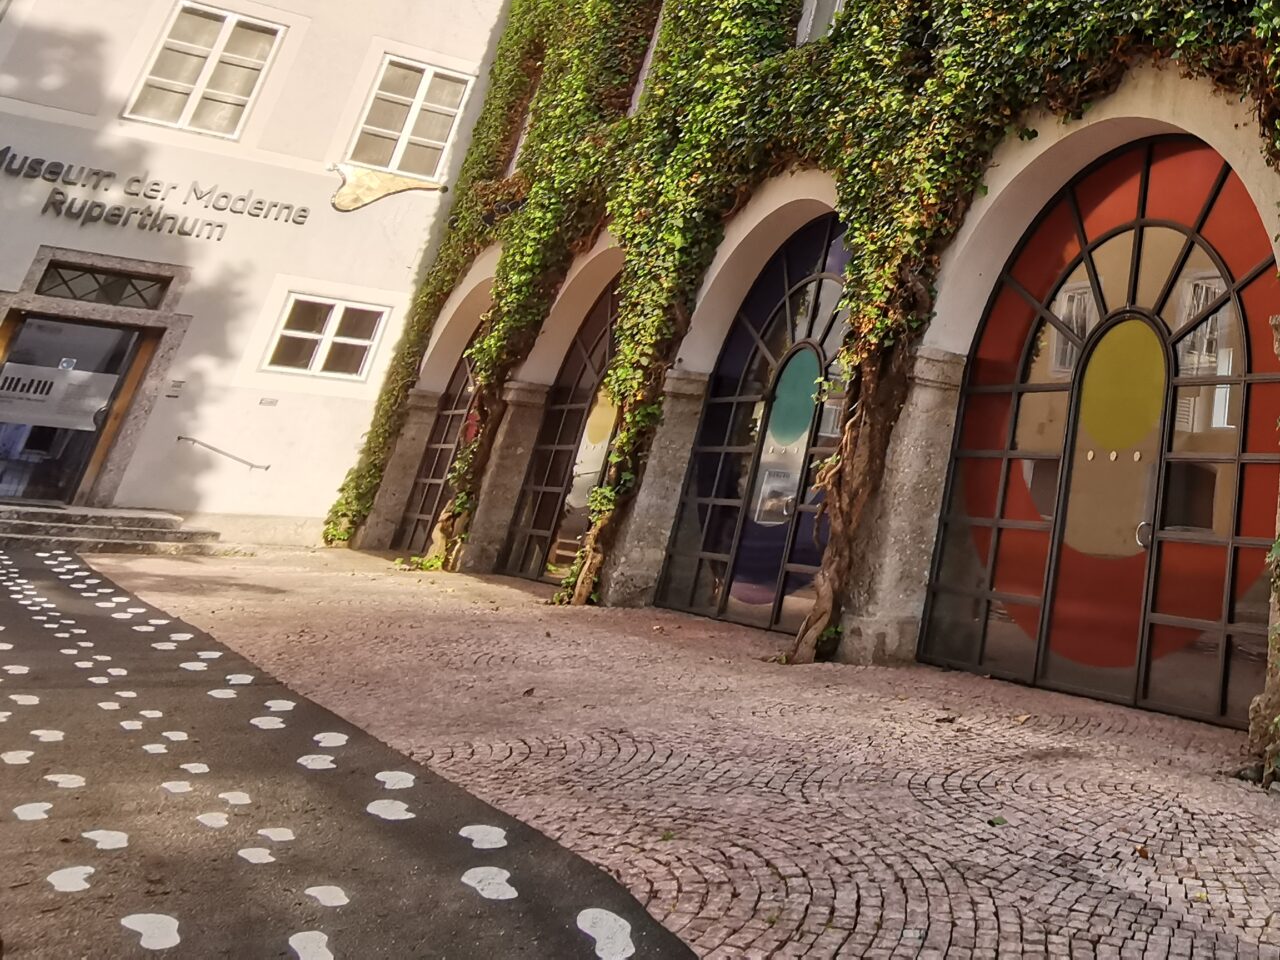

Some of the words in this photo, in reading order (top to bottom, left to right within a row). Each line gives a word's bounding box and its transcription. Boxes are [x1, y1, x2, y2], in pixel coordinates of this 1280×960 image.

[41, 187, 228, 241] Rupertinum
[124, 170, 179, 201] der
[183, 180, 311, 225] Moderne
